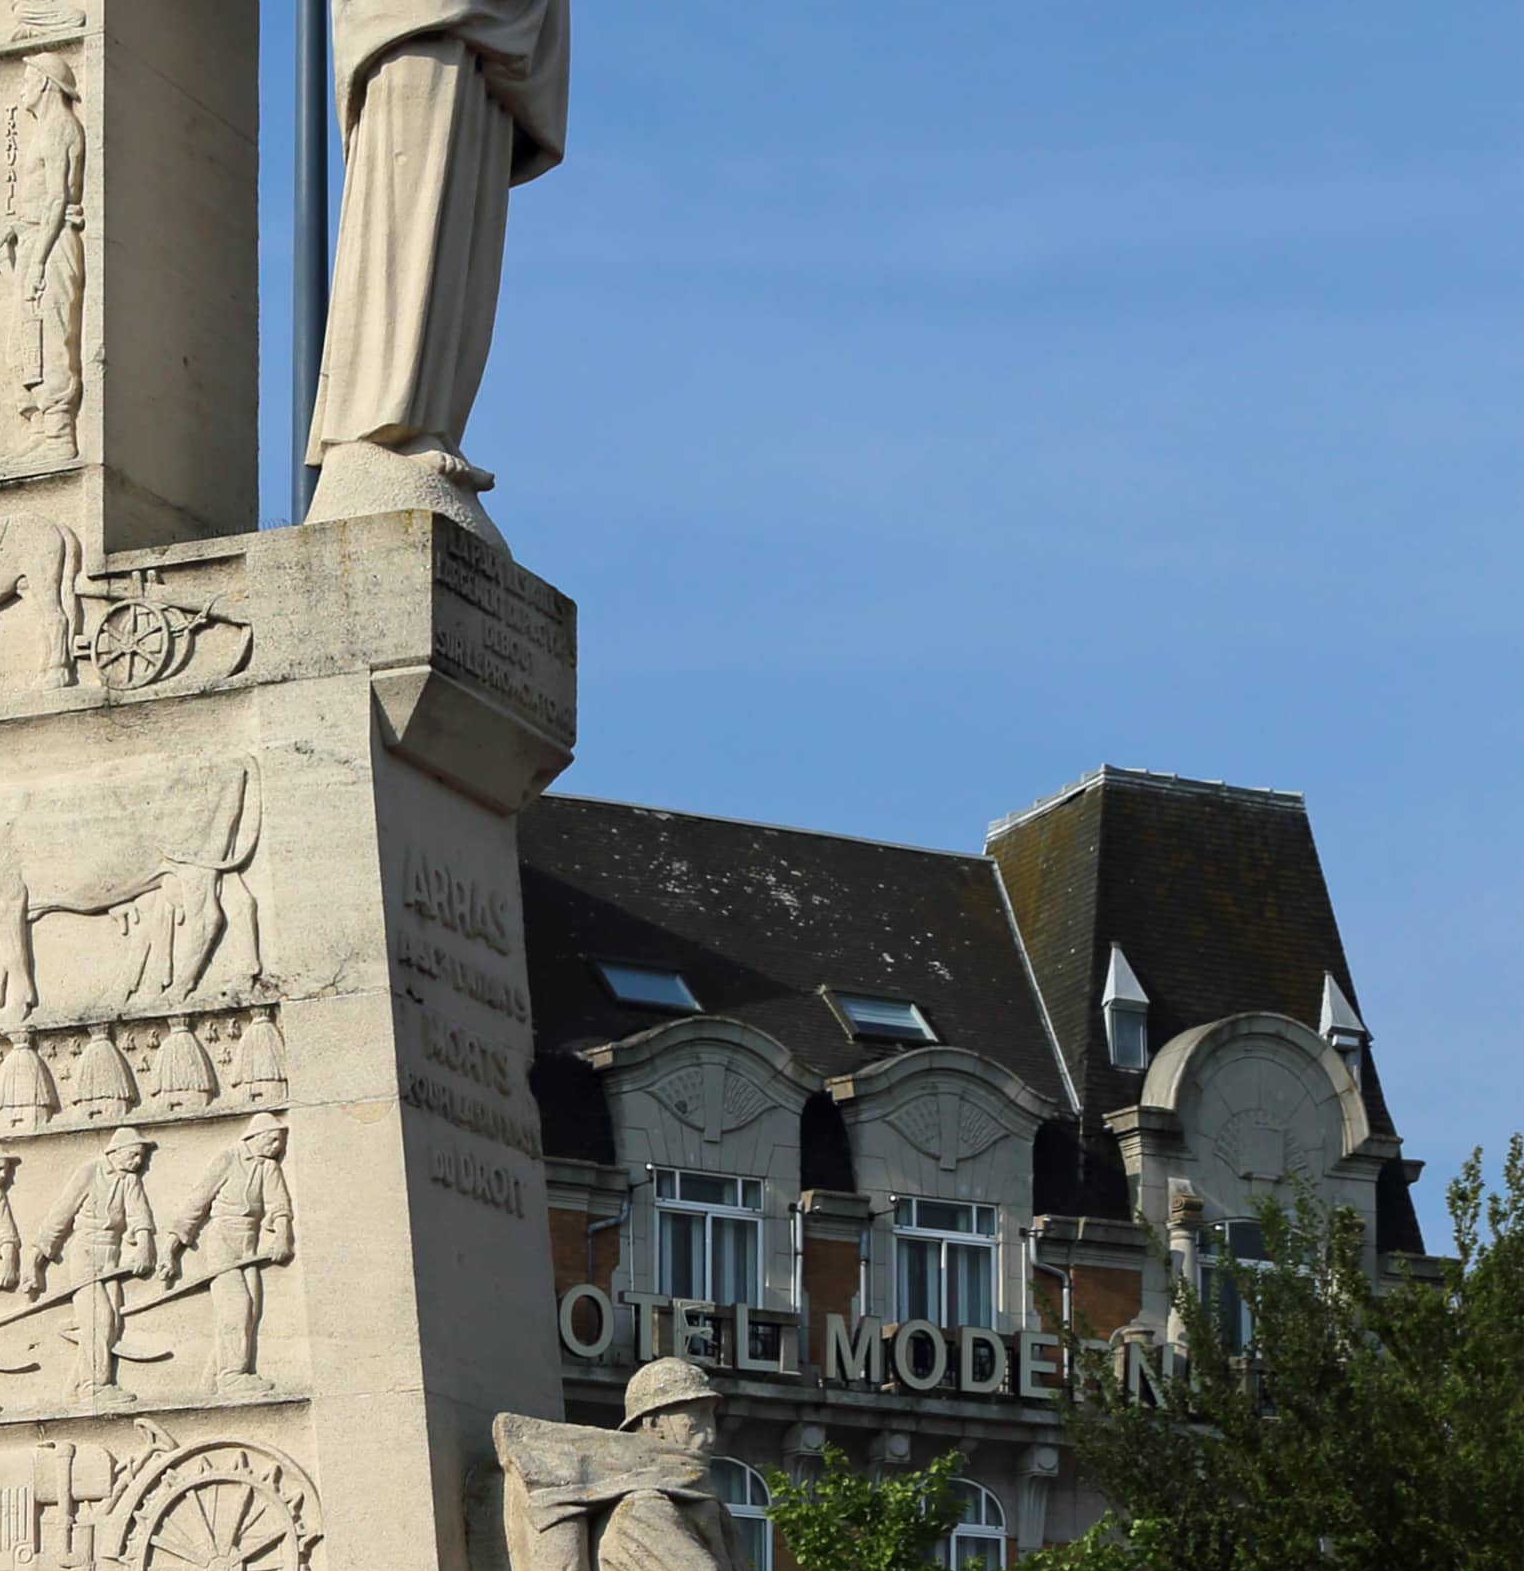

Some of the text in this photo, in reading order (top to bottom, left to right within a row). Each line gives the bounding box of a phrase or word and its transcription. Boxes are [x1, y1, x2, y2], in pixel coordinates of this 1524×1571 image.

[5, 104, 18, 216] TRAVAIL
[402, 847, 509, 957] ARRAS
[421, 1013, 511, 1097] MORTS
[429, 1142, 525, 1220] DU DROIT
[558, 1283, 783, 1374] OTEL
